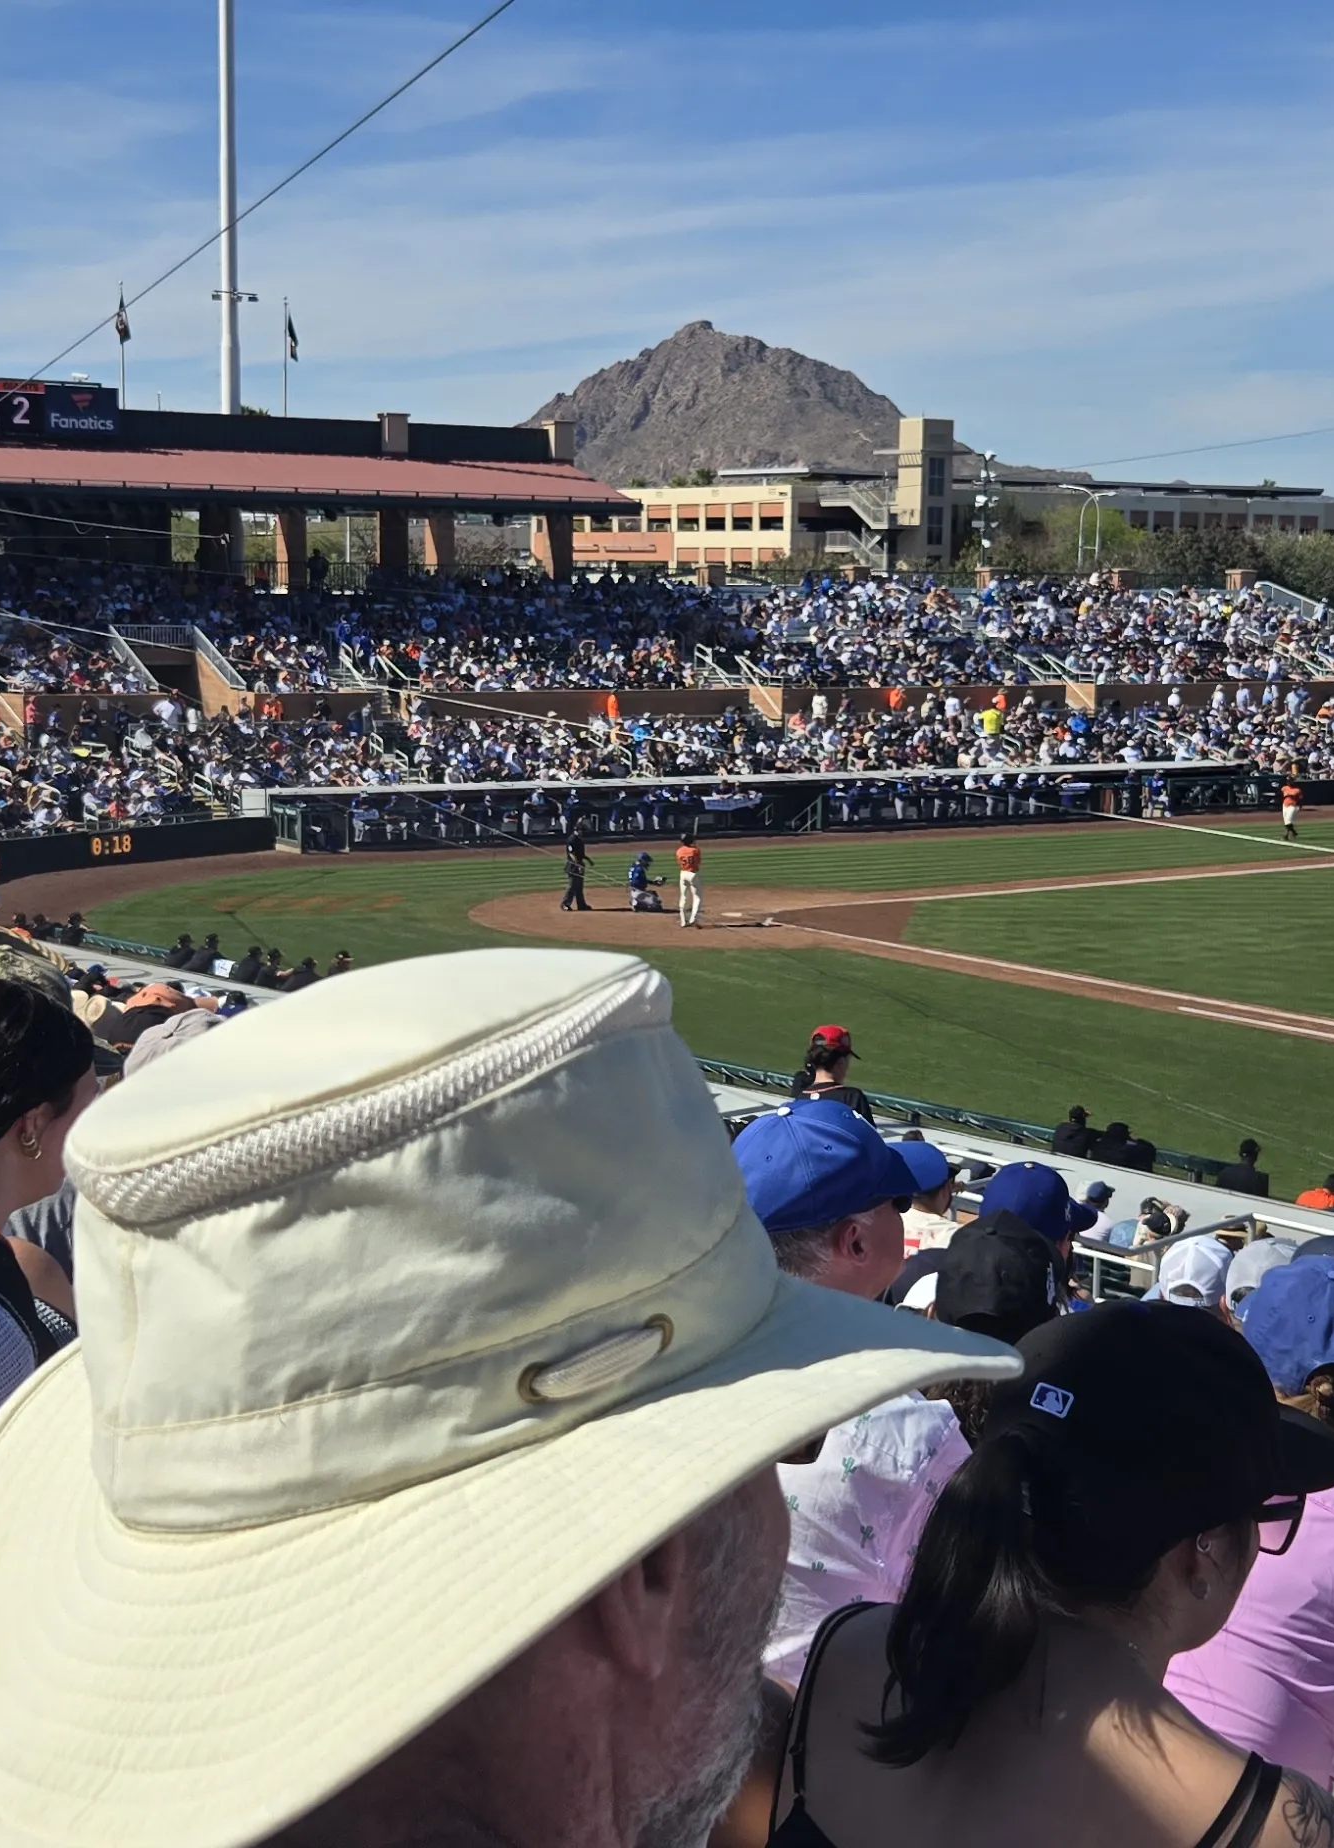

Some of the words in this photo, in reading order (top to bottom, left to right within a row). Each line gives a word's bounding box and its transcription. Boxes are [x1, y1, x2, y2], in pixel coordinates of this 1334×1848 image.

[12, 396, 30, 424] 2
[50, 412, 114, 430] Fanatics
[92, 834, 132, 856] 0:18
